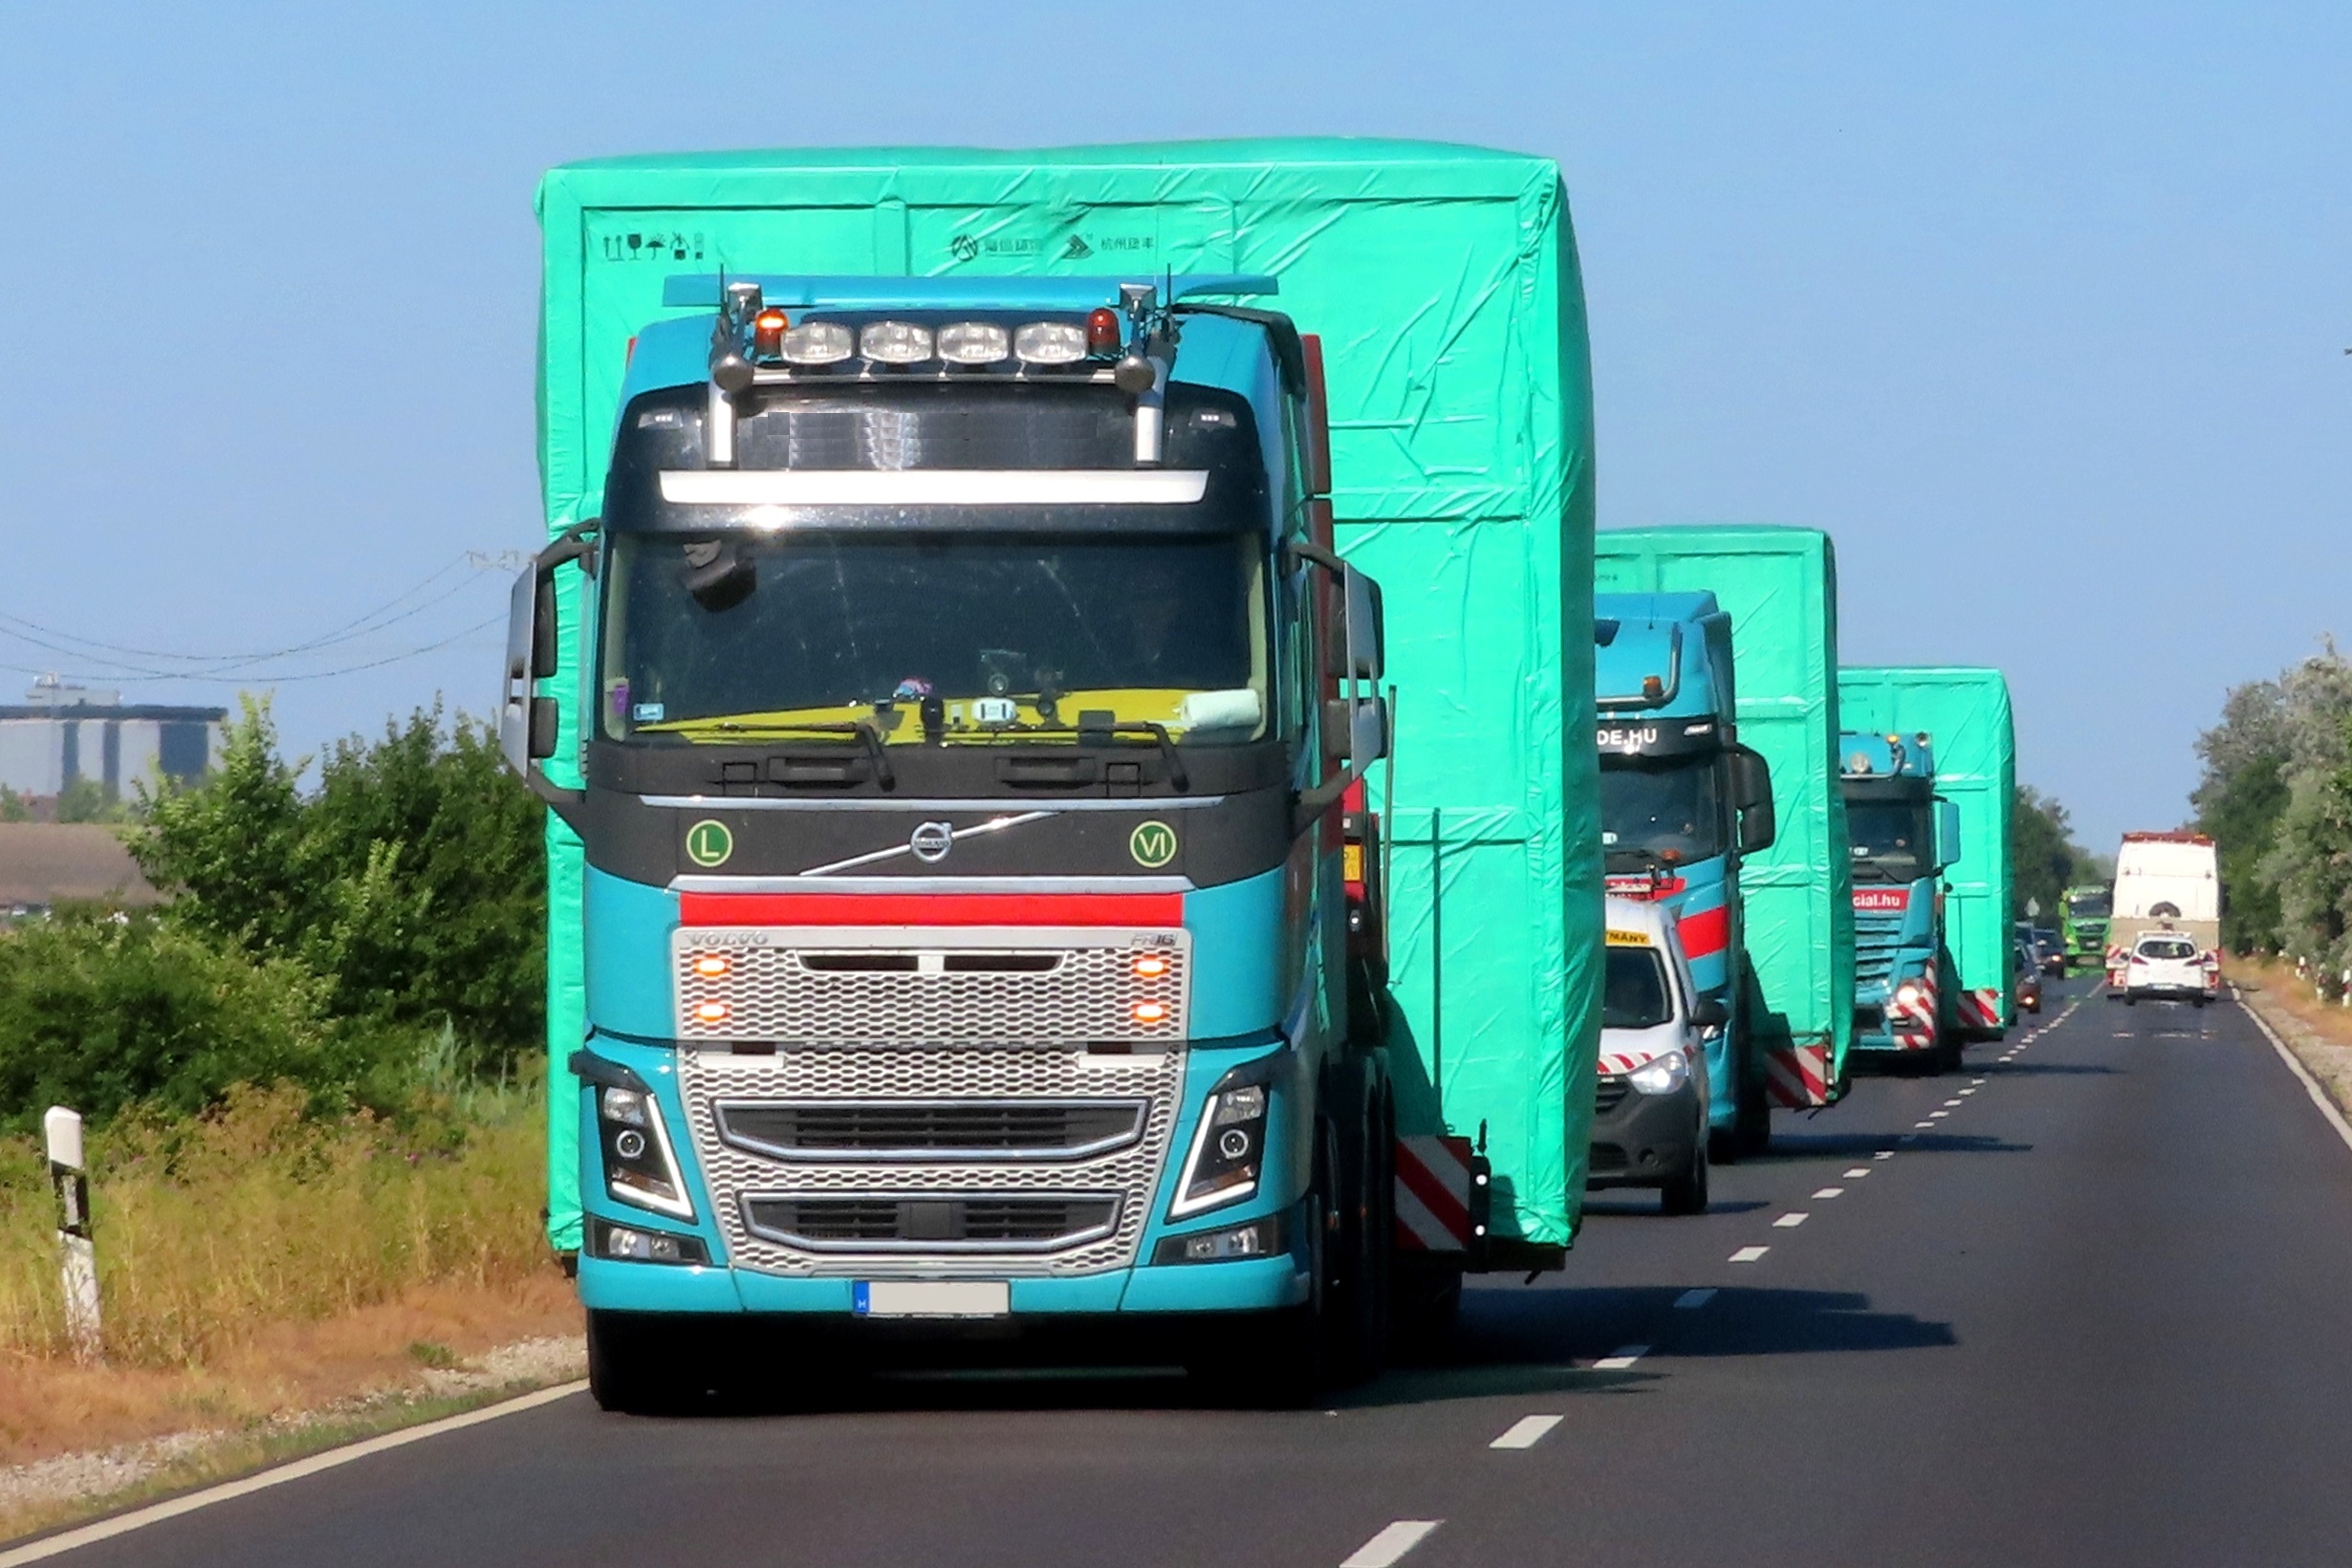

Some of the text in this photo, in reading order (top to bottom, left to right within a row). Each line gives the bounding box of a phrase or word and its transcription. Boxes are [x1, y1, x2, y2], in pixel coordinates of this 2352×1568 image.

[701, 829, 719, 858] L
[1138, 832, 1165, 859] VI
[686, 932, 769, 946] VOLVO
